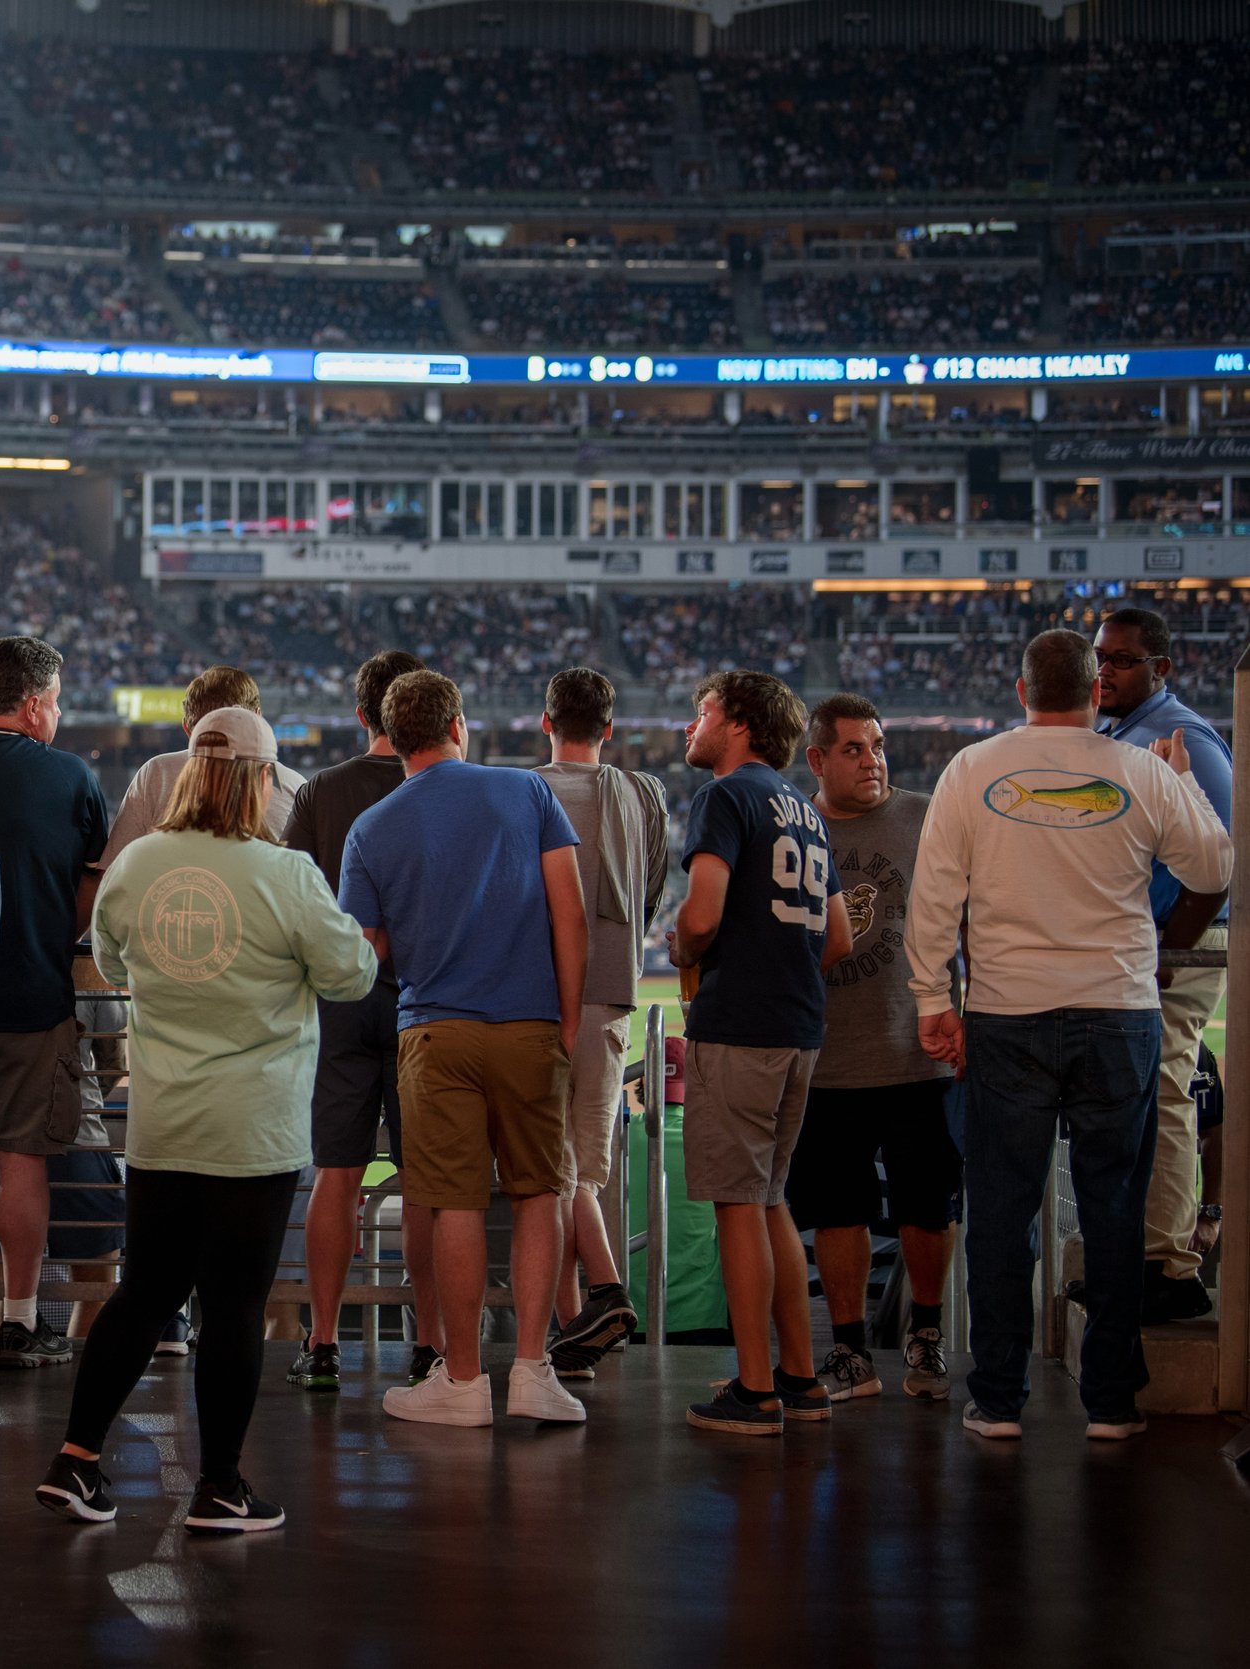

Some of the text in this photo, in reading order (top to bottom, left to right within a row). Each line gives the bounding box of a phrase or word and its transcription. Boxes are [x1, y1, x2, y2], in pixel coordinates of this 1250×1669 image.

[718, 359, 762, 380] NOW
[933, 354, 1130, 379] #12 CHASE HEADLEY
[1137, 437, 1205, 459] World
[833, 847, 905, 893] ANT
[771, 835, 829, 932] 99
